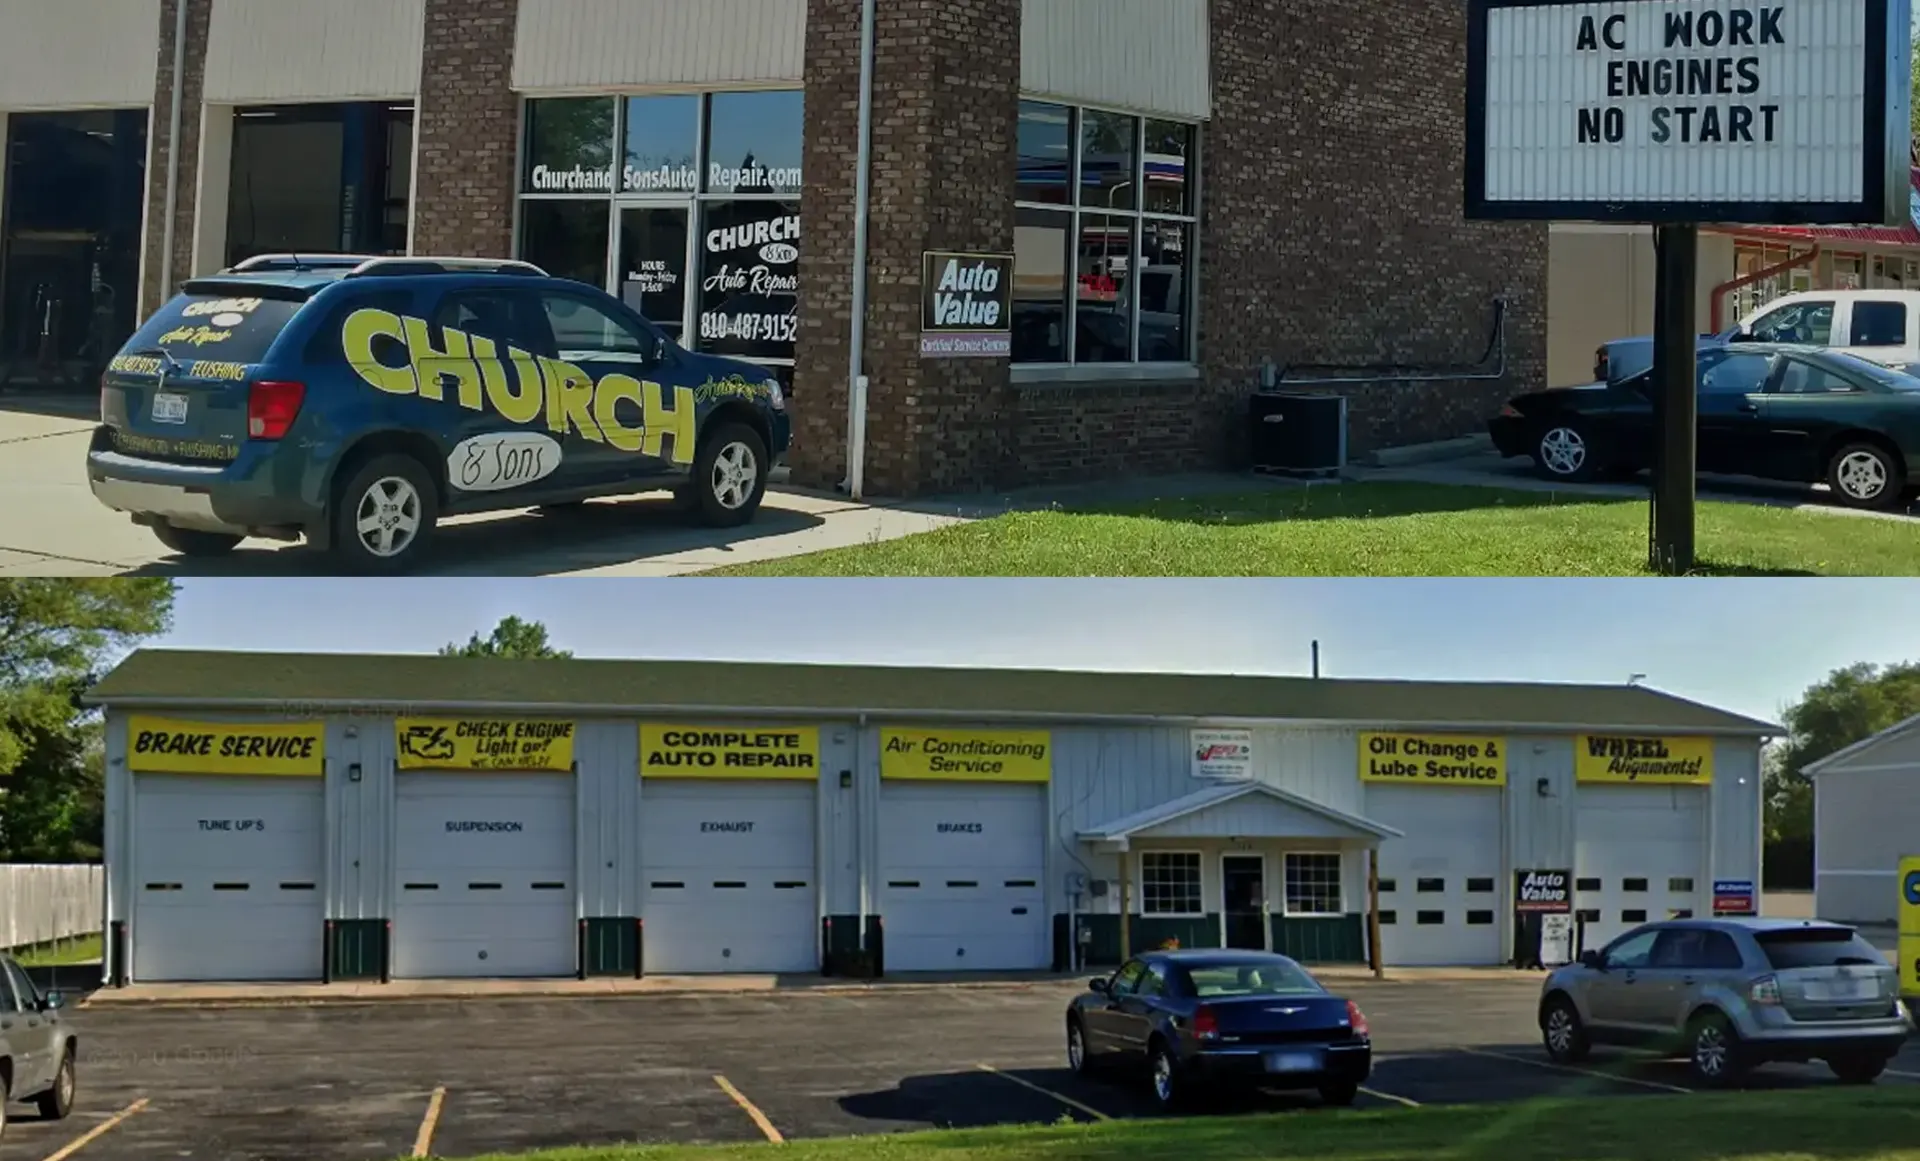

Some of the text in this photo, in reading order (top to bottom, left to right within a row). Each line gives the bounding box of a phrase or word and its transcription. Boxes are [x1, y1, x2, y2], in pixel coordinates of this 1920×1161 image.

[1576, 7, 1785, 50] AC WORK
[1607, 57, 1760, 97] ENGINES
[1577, 105, 1779, 143] NO START
[706, 216, 800, 253] CHURCH
[641, 260, 665, 271] HOURS
[938, 258, 999, 292] Auto
[703, 264, 800, 299] Auto Repair
[934, 292, 1000, 326] Value
[701, 312, 798, 341] 810-487-9152
[954, 339, 981, 352] Service
[190, 360, 248, 381] FLUSHING
[342, 308, 697, 464] CHURCH
[461, 438, 543, 486] & Sons
[456, 721, 573, 739] CHECK ENGINE
[662, 731, 800, 748] COMPLETE
[134, 730, 316, 759] BRAKE SERVICE
[476, 738, 518, 758] Light
[885, 736, 1046, 760] Air Conditioning
[1369, 736, 1499, 761] Oil Change &
[1587, 735, 1669, 758] WHEEL
[647, 751, 814, 768] AUTO REPAIR
[929, 755, 1004, 774] Service
[1370, 758, 1498, 780] Lube Service
[197, 820, 265, 831] TUNE UP'S
[445, 820, 523, 833] SUSPENSION
[700, 821, 755, 833] EXHAUST
[936, 822, 983, 833] BRAKES
[1523, 871, 1565, 888] Auto
[1521, 886, 1566, 901] Value
